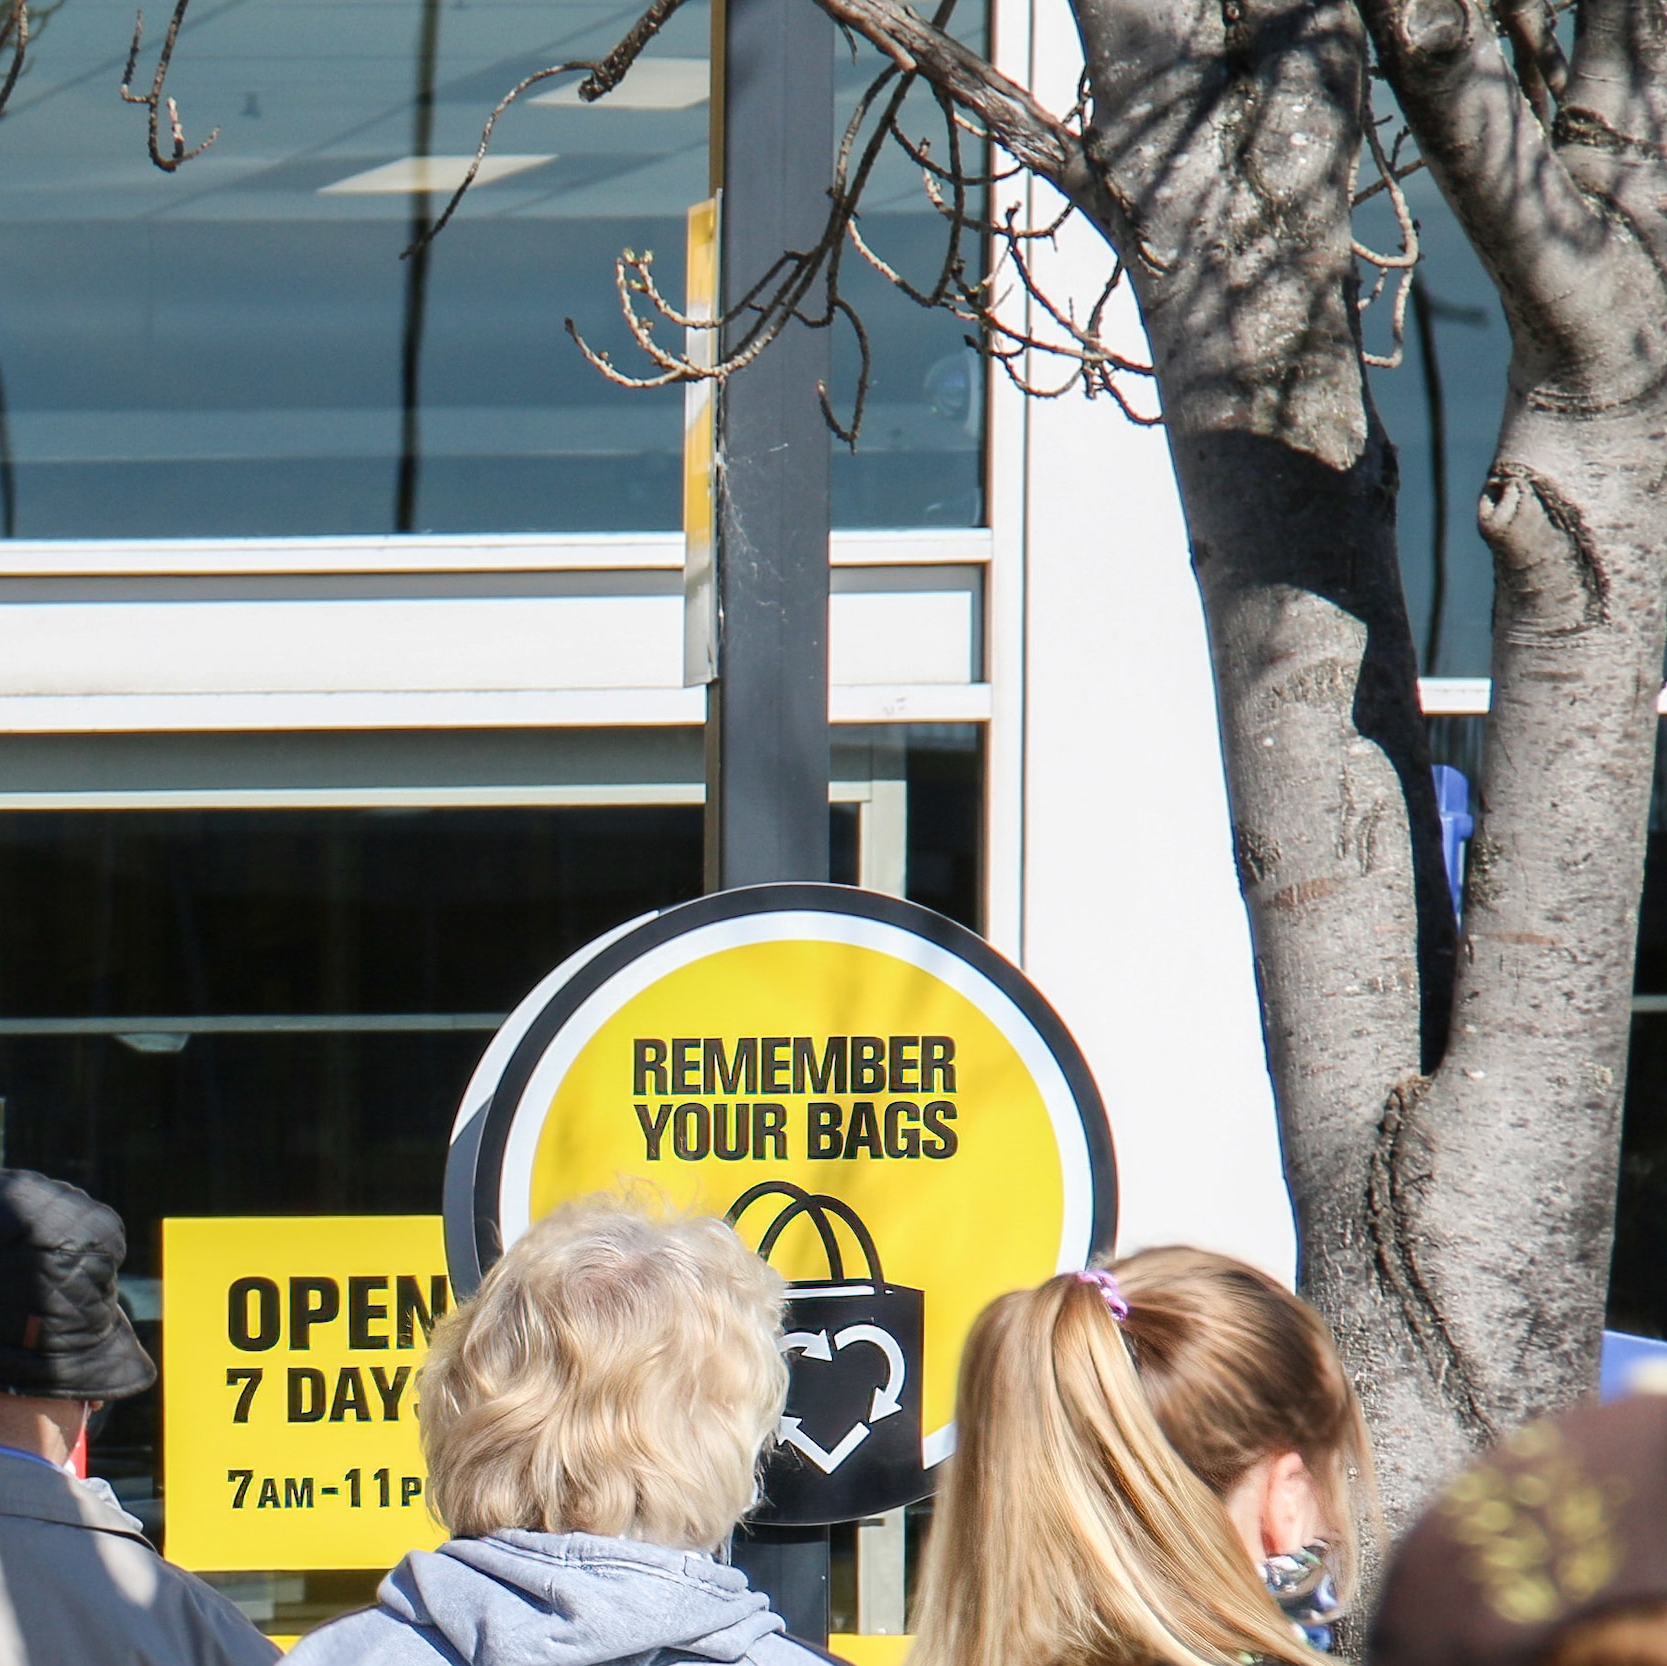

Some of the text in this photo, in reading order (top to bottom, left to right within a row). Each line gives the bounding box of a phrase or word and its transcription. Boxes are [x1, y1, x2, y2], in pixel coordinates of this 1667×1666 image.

[632, 1035, 958, 1096] REMEMBER
[633, 1100, 959, 1162] YOUR BAGS
[227, 1275, 448, 1352] OPEN
[225, 1366, 420, 1424] 7 DAY
[227, 1467, 423, 1509] 7AM-11P
